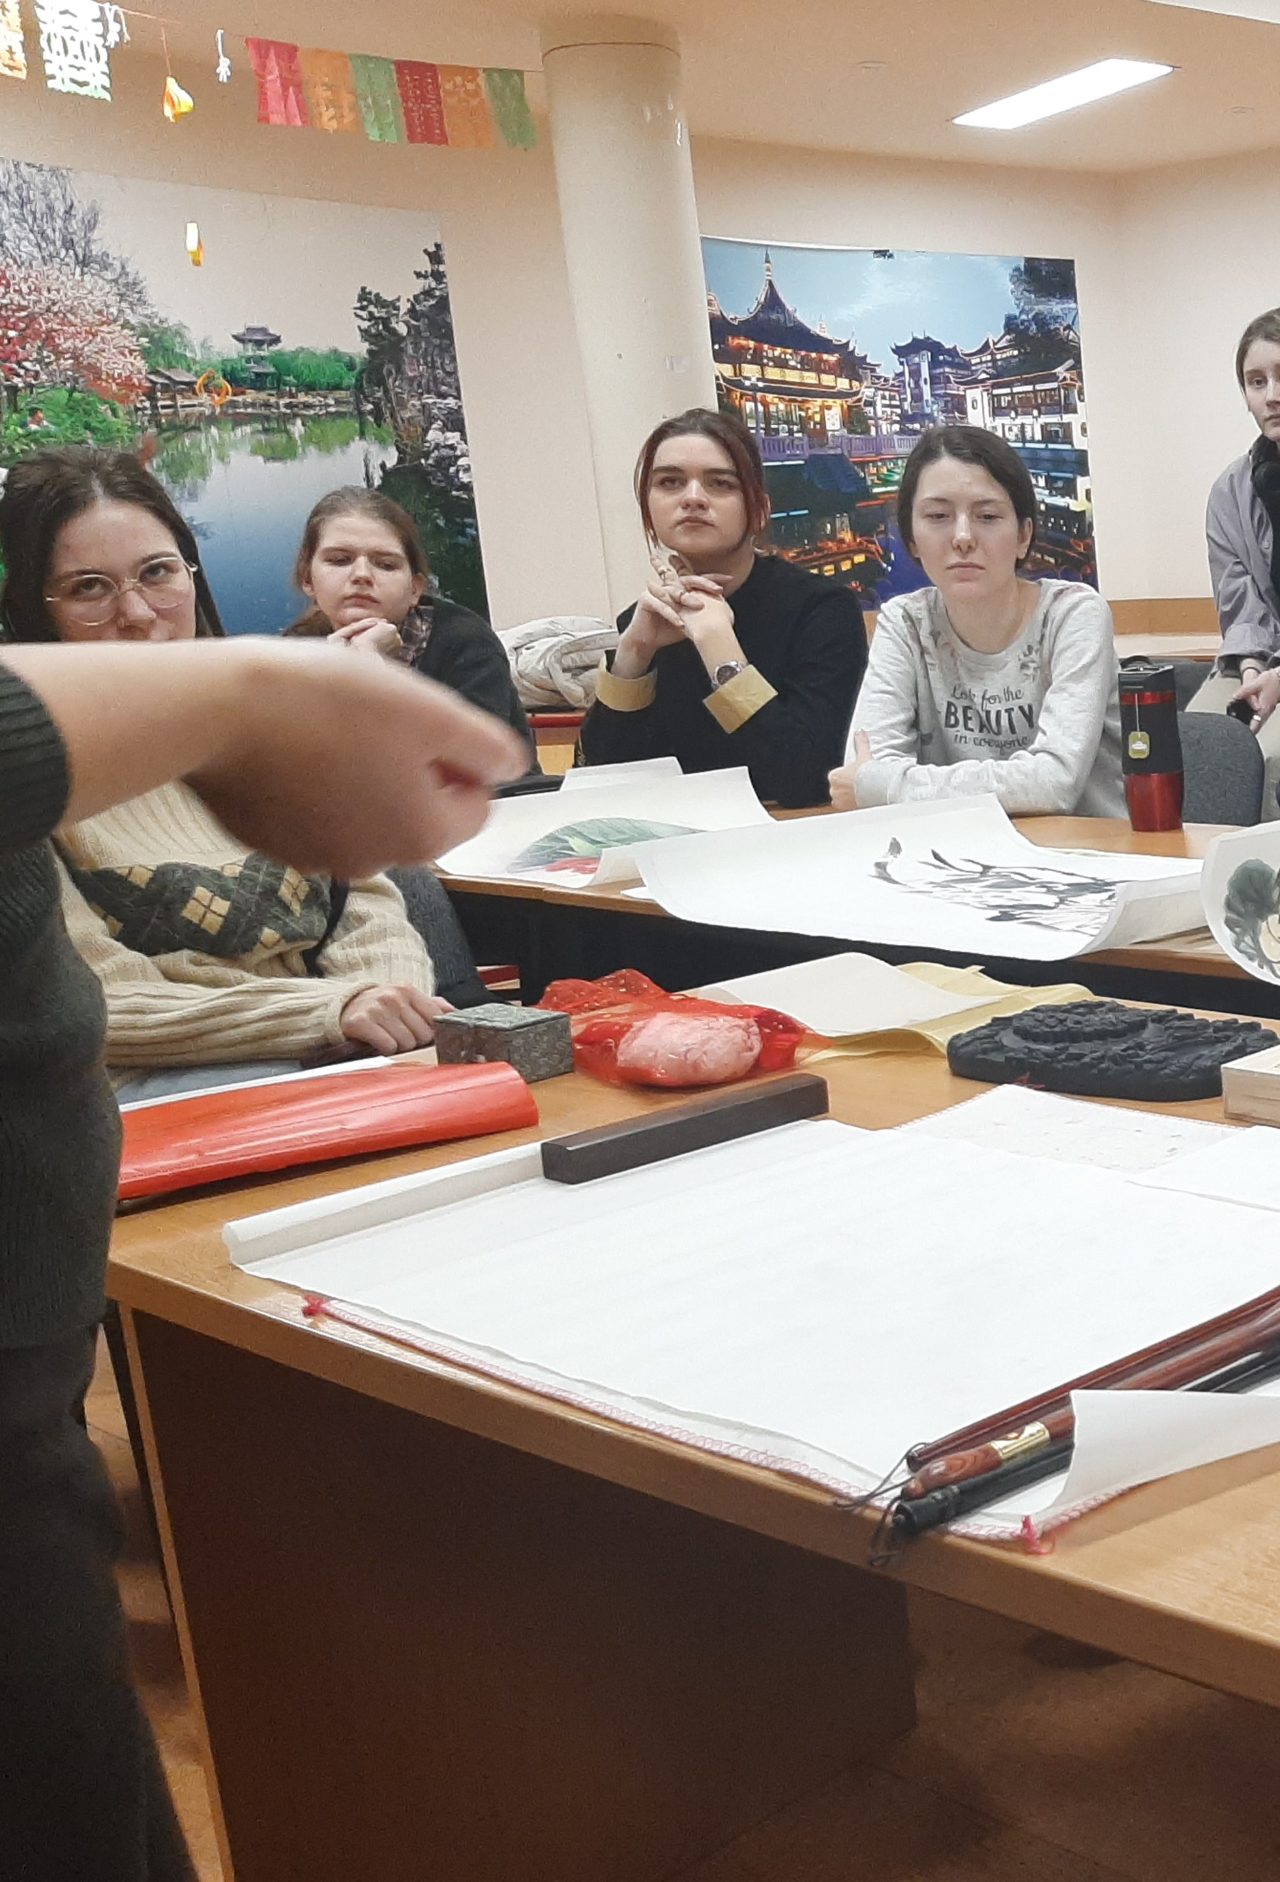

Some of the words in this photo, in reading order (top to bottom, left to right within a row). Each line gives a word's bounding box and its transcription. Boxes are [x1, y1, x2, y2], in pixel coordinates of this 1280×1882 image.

[952, 685, 976, 701] Lok
[982, 689, 1001, 711] for
[1003, 686, 1024, 702] the
[944, 700, 1035, 736] BEAUTY
[953, 730, 968, 744] in
